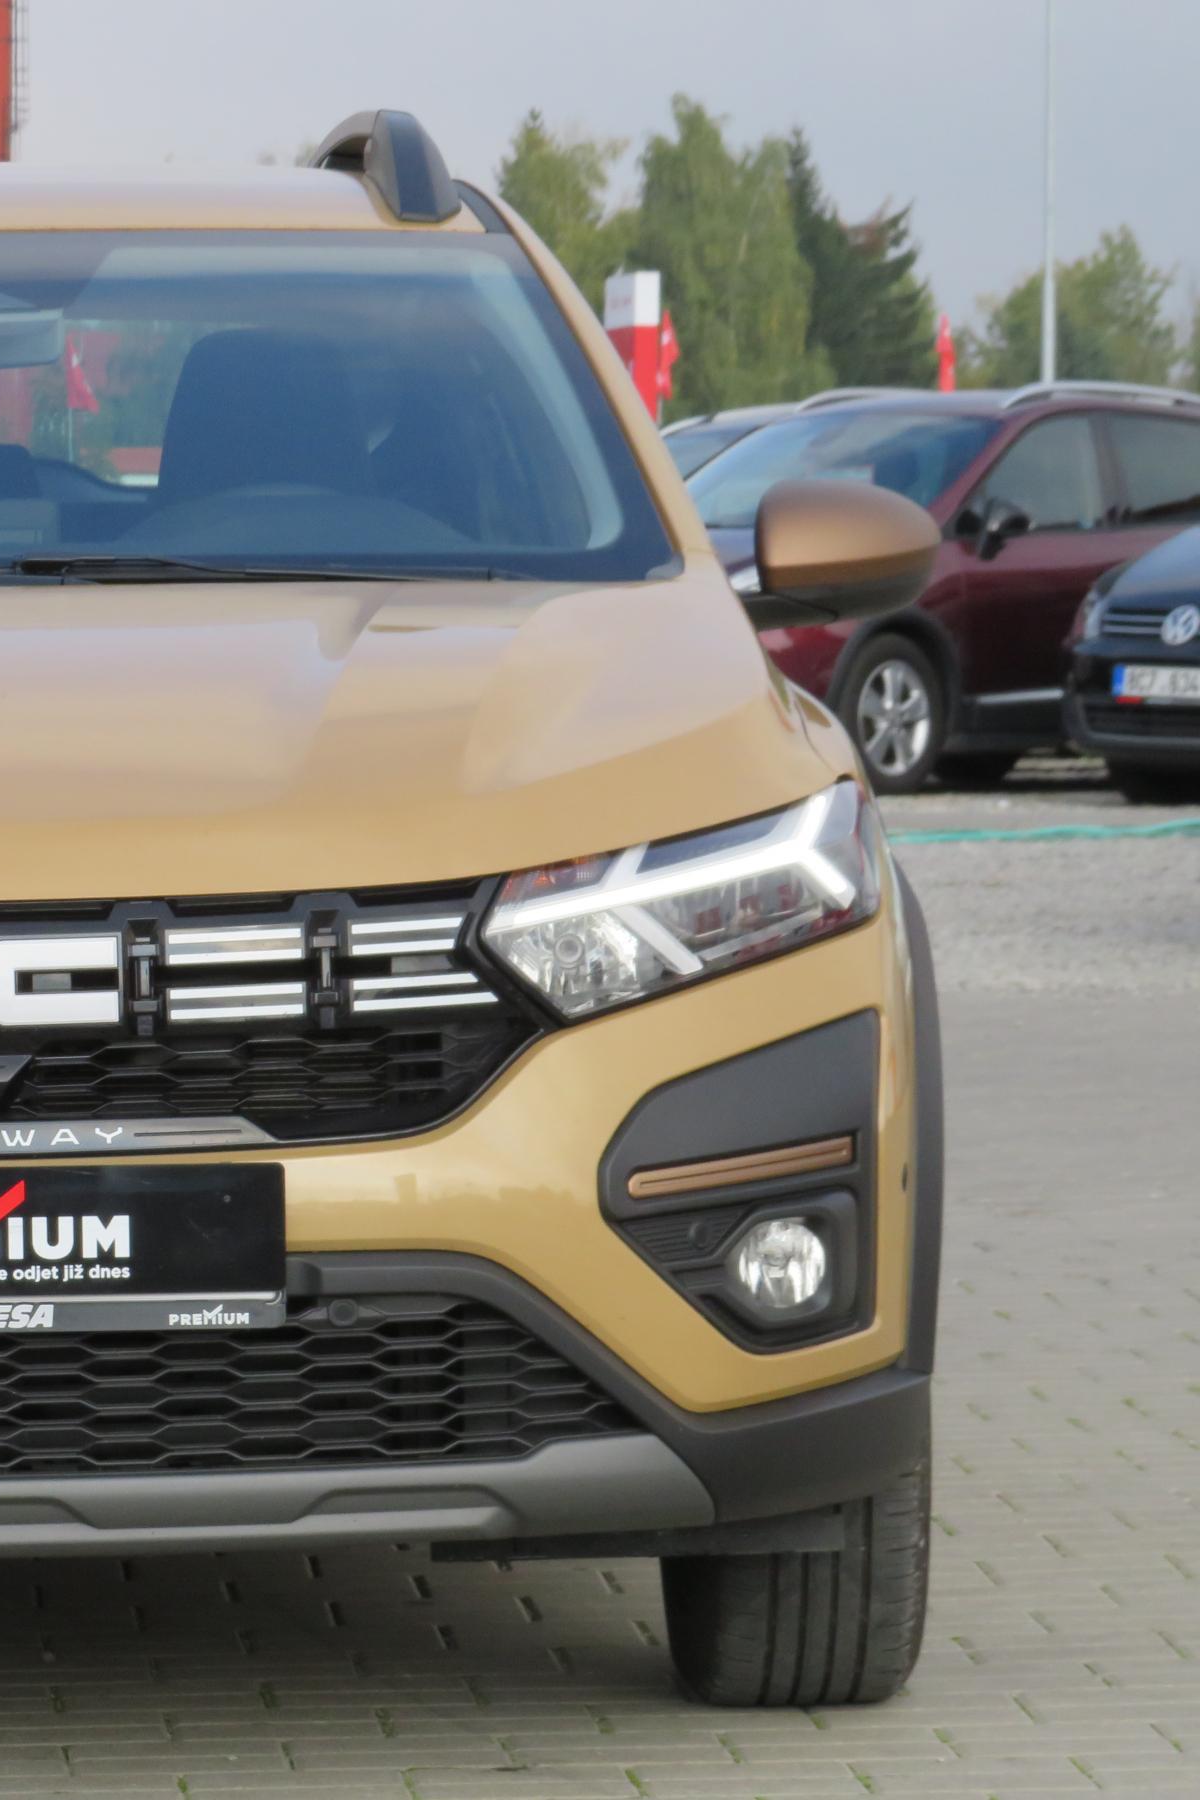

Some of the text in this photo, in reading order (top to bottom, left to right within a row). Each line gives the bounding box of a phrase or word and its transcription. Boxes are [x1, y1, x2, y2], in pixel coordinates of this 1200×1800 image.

[12, 1264, 60, 1283] odjet
[62, 1263, 84, 1283] již
[88, 1263, 131, 1280] dnes
[168, 1304, 250, 1326] PREMIUM
